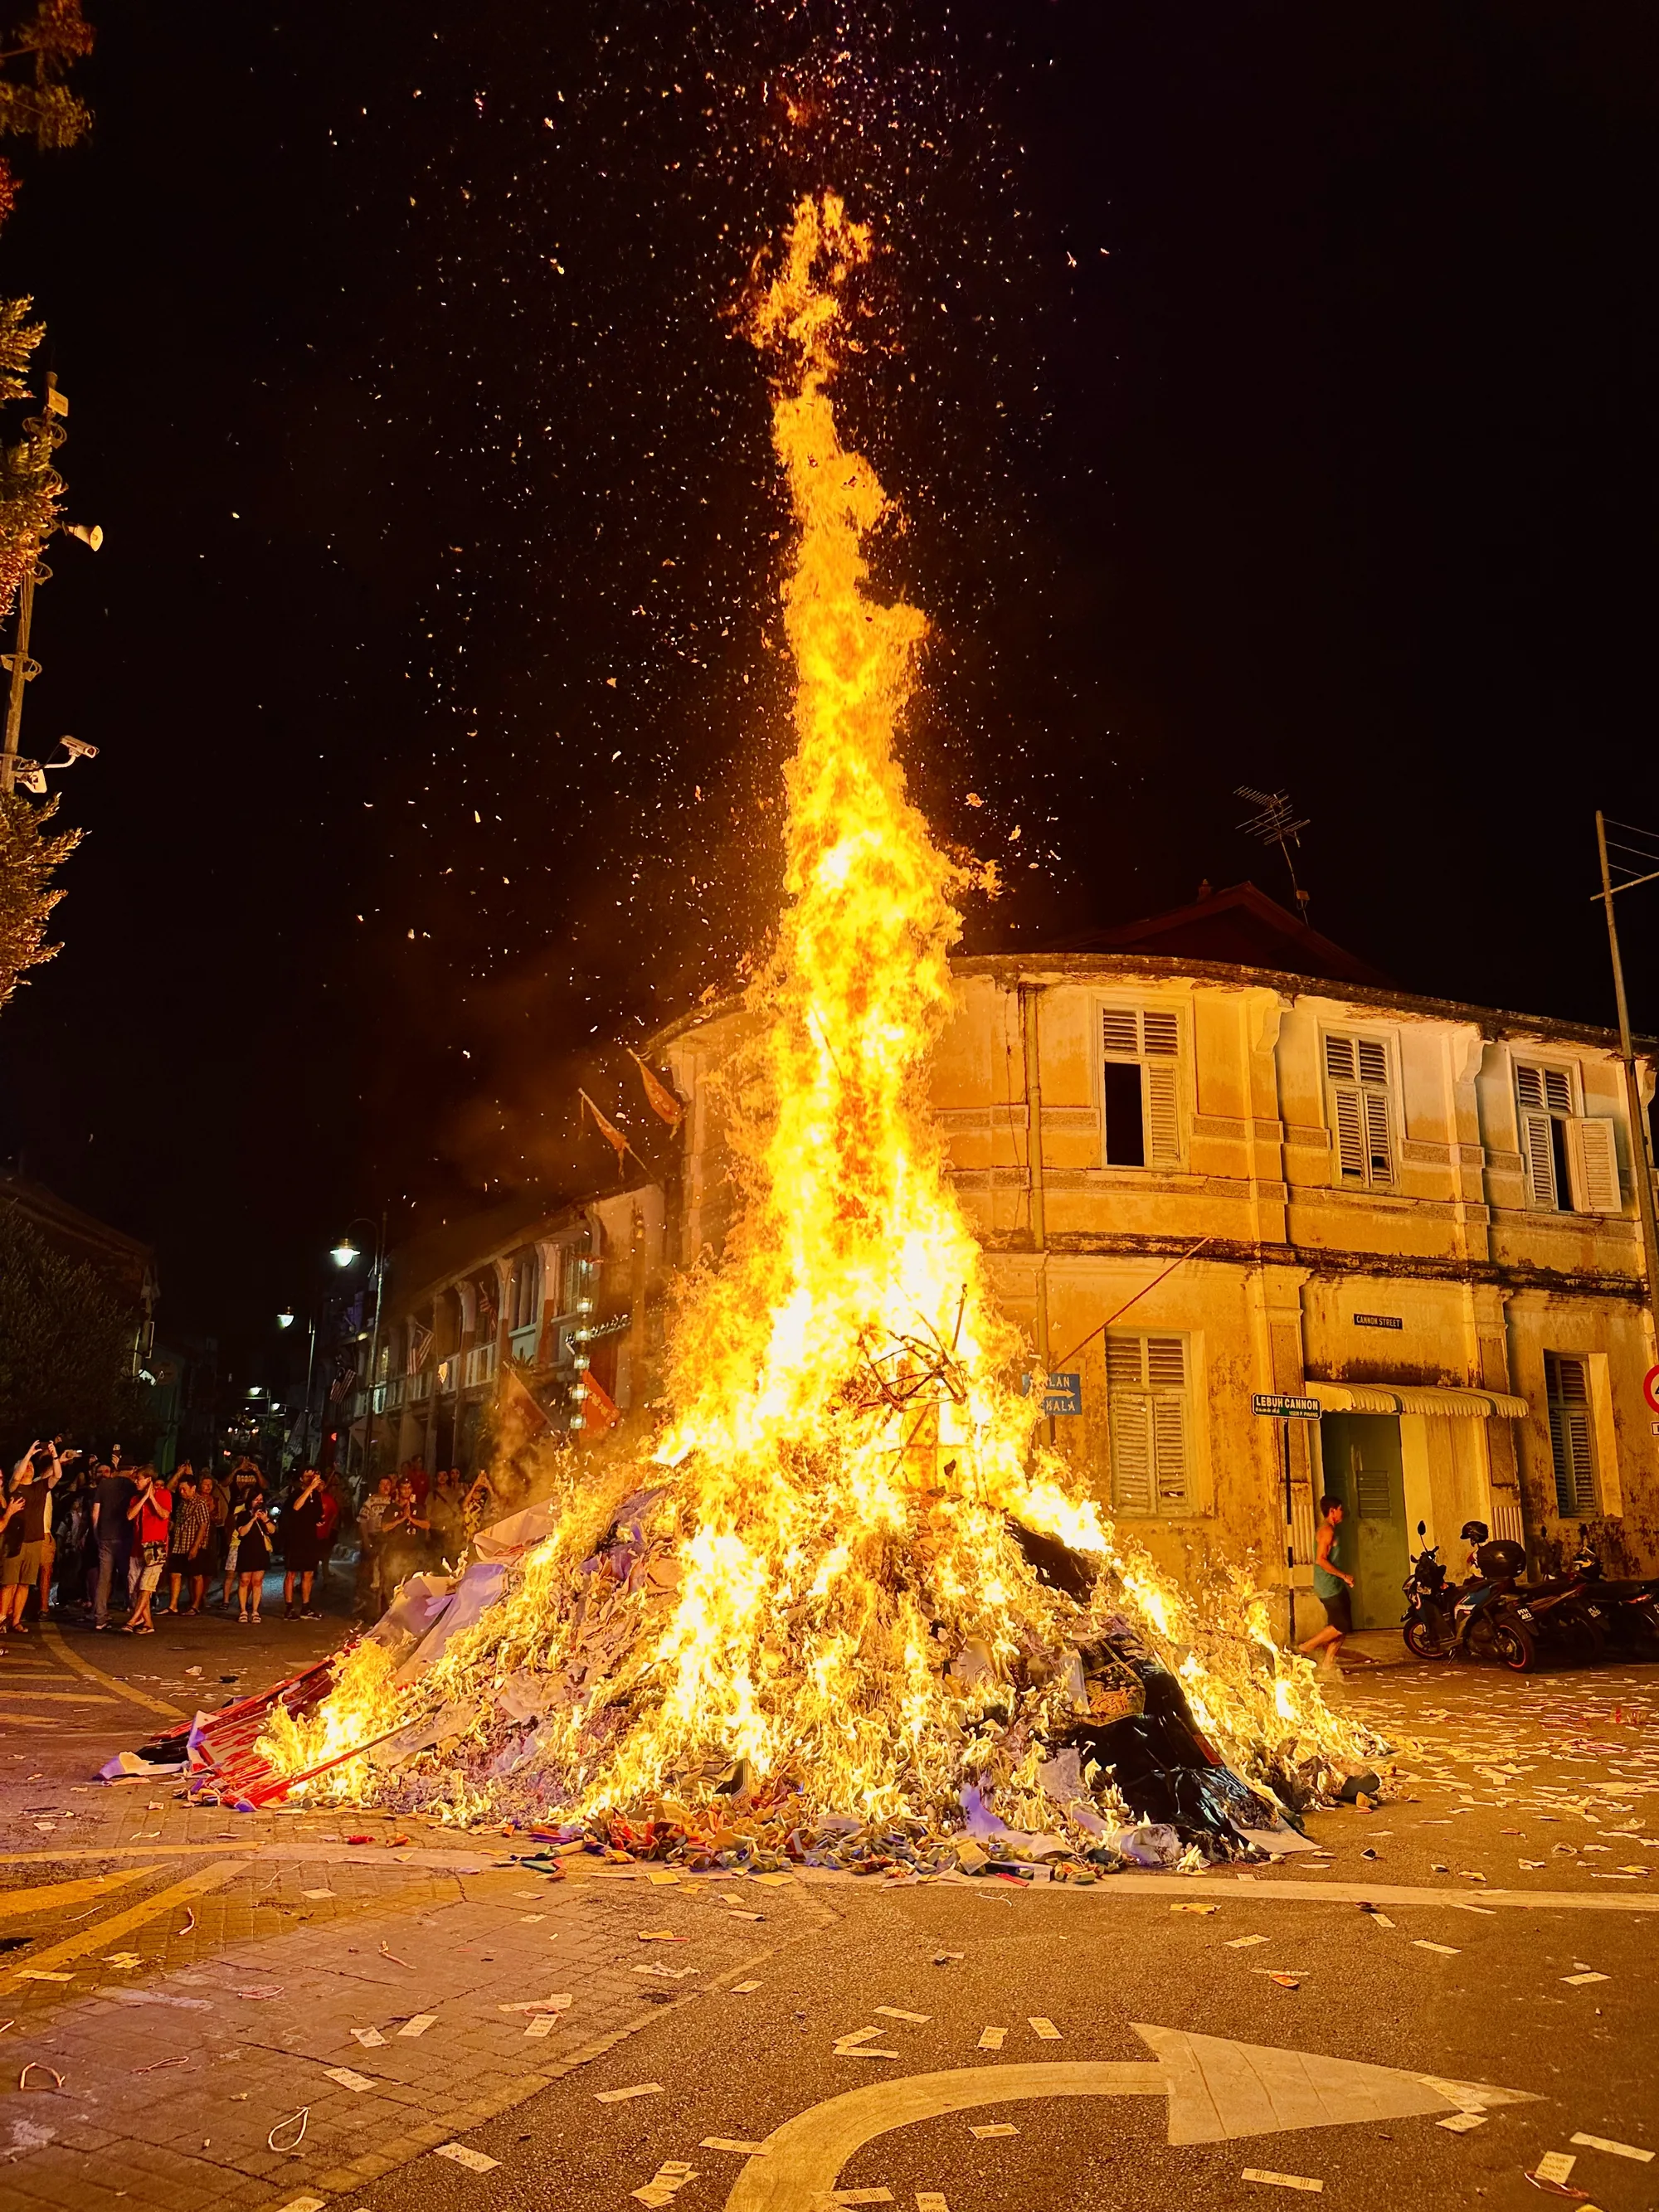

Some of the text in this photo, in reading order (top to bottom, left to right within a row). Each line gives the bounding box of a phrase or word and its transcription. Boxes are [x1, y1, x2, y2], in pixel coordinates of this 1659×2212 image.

[1356, 1315, 1400, 1327] CANNON STREET
[1042, 1400, 1075, 1412] HALA
[1256, 1396, 1283, 1408] LEBUH
[1284, 1398, 1318, 1411] CANNON
